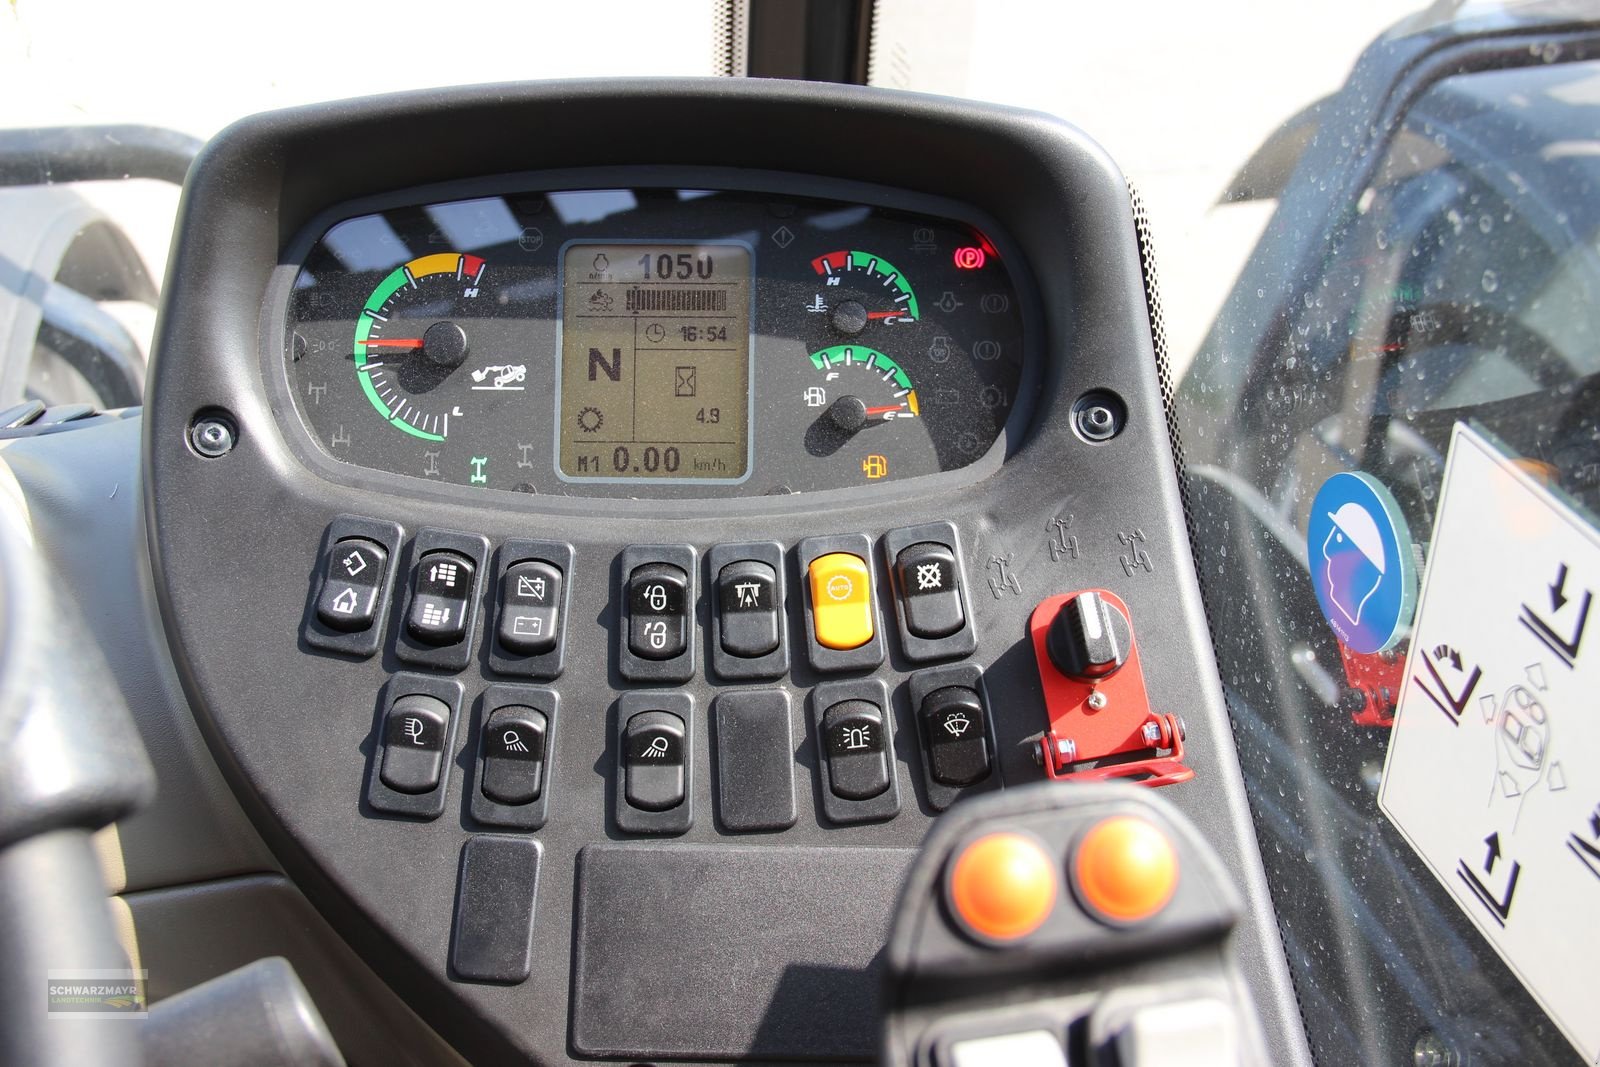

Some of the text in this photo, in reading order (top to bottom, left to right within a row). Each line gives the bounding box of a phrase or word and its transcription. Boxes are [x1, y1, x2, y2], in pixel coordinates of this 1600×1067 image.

[520, 235, 541, 244] STOP
[966, 252, 975, 265] P
[638, 253, 714, 280] 1050
[826, 277, 840, 286] H
[464, 287, 478, 298] H
[680, 325, 728, 342] 16:54
[588, 347, 622, 382] N
[825, 373, 840, 382] F
[452, 406, 464, 417] L
[882, 411, 897, 421] E
[577, 446, 727, 473] M1 0.00 km/h
